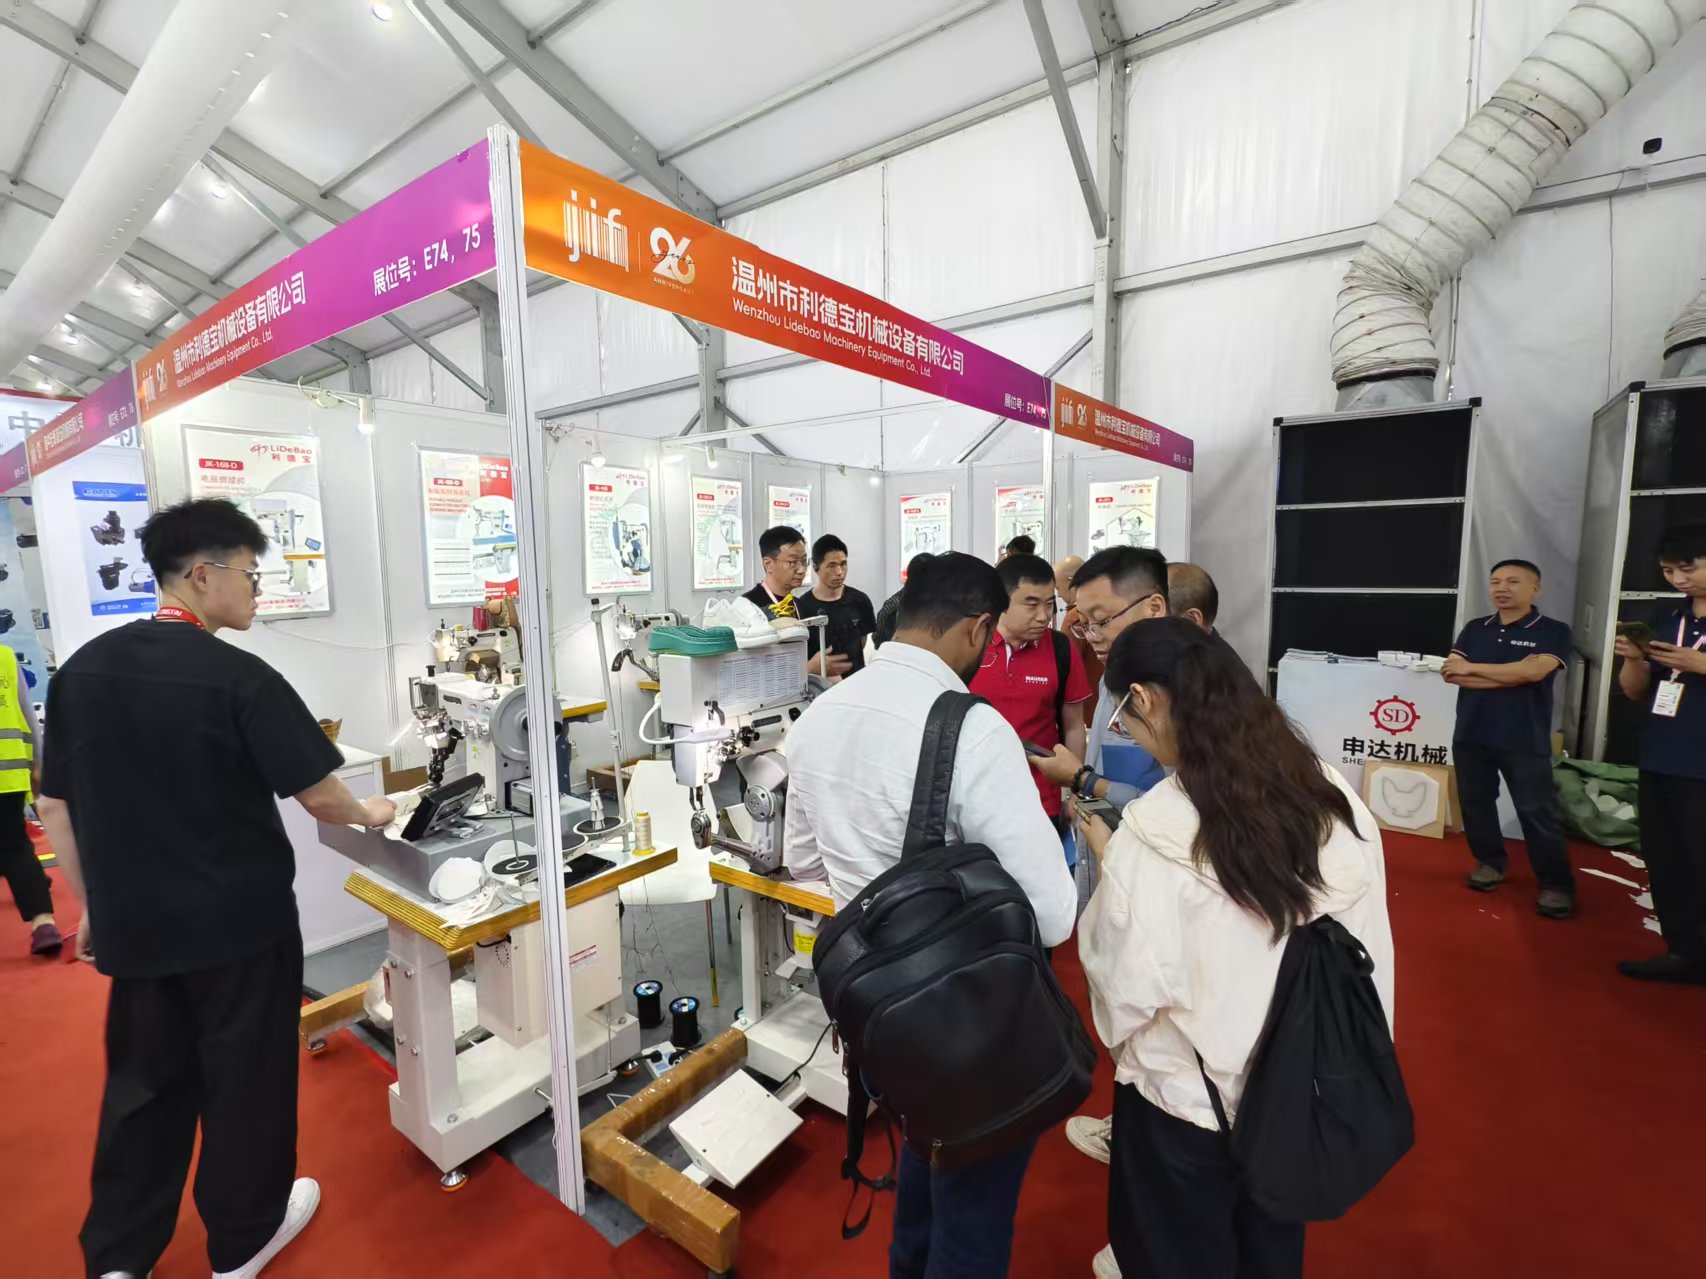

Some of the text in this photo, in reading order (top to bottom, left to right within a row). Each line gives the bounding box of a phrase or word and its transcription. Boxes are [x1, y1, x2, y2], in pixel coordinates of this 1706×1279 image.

[373, 256, 417, 296] 展位号：
[463, 223, 481, 252] 75
[650, 227, 696, 285] 26
[173, 271, 306, 375] 温州市利德宝机械设备有限公司
[732, 256, 965, 376] 温州市利德宝机械设备有限公司
[733, 297, 933, 378] Wenzhou Lidebao Machinery Equipment Co., Ltd.
[205, 355, 227, 373] Machinery
[226, 340, 251, 362] Equipment
[262, 328, 273, 344] Ltd.
[270, 445, 313, 455] LiDeBao
[1382, 707, 1410, 724] SD
[1342, 736, 1448, 766] 申达机械
[1342, 756, 1364, 766] SHE
